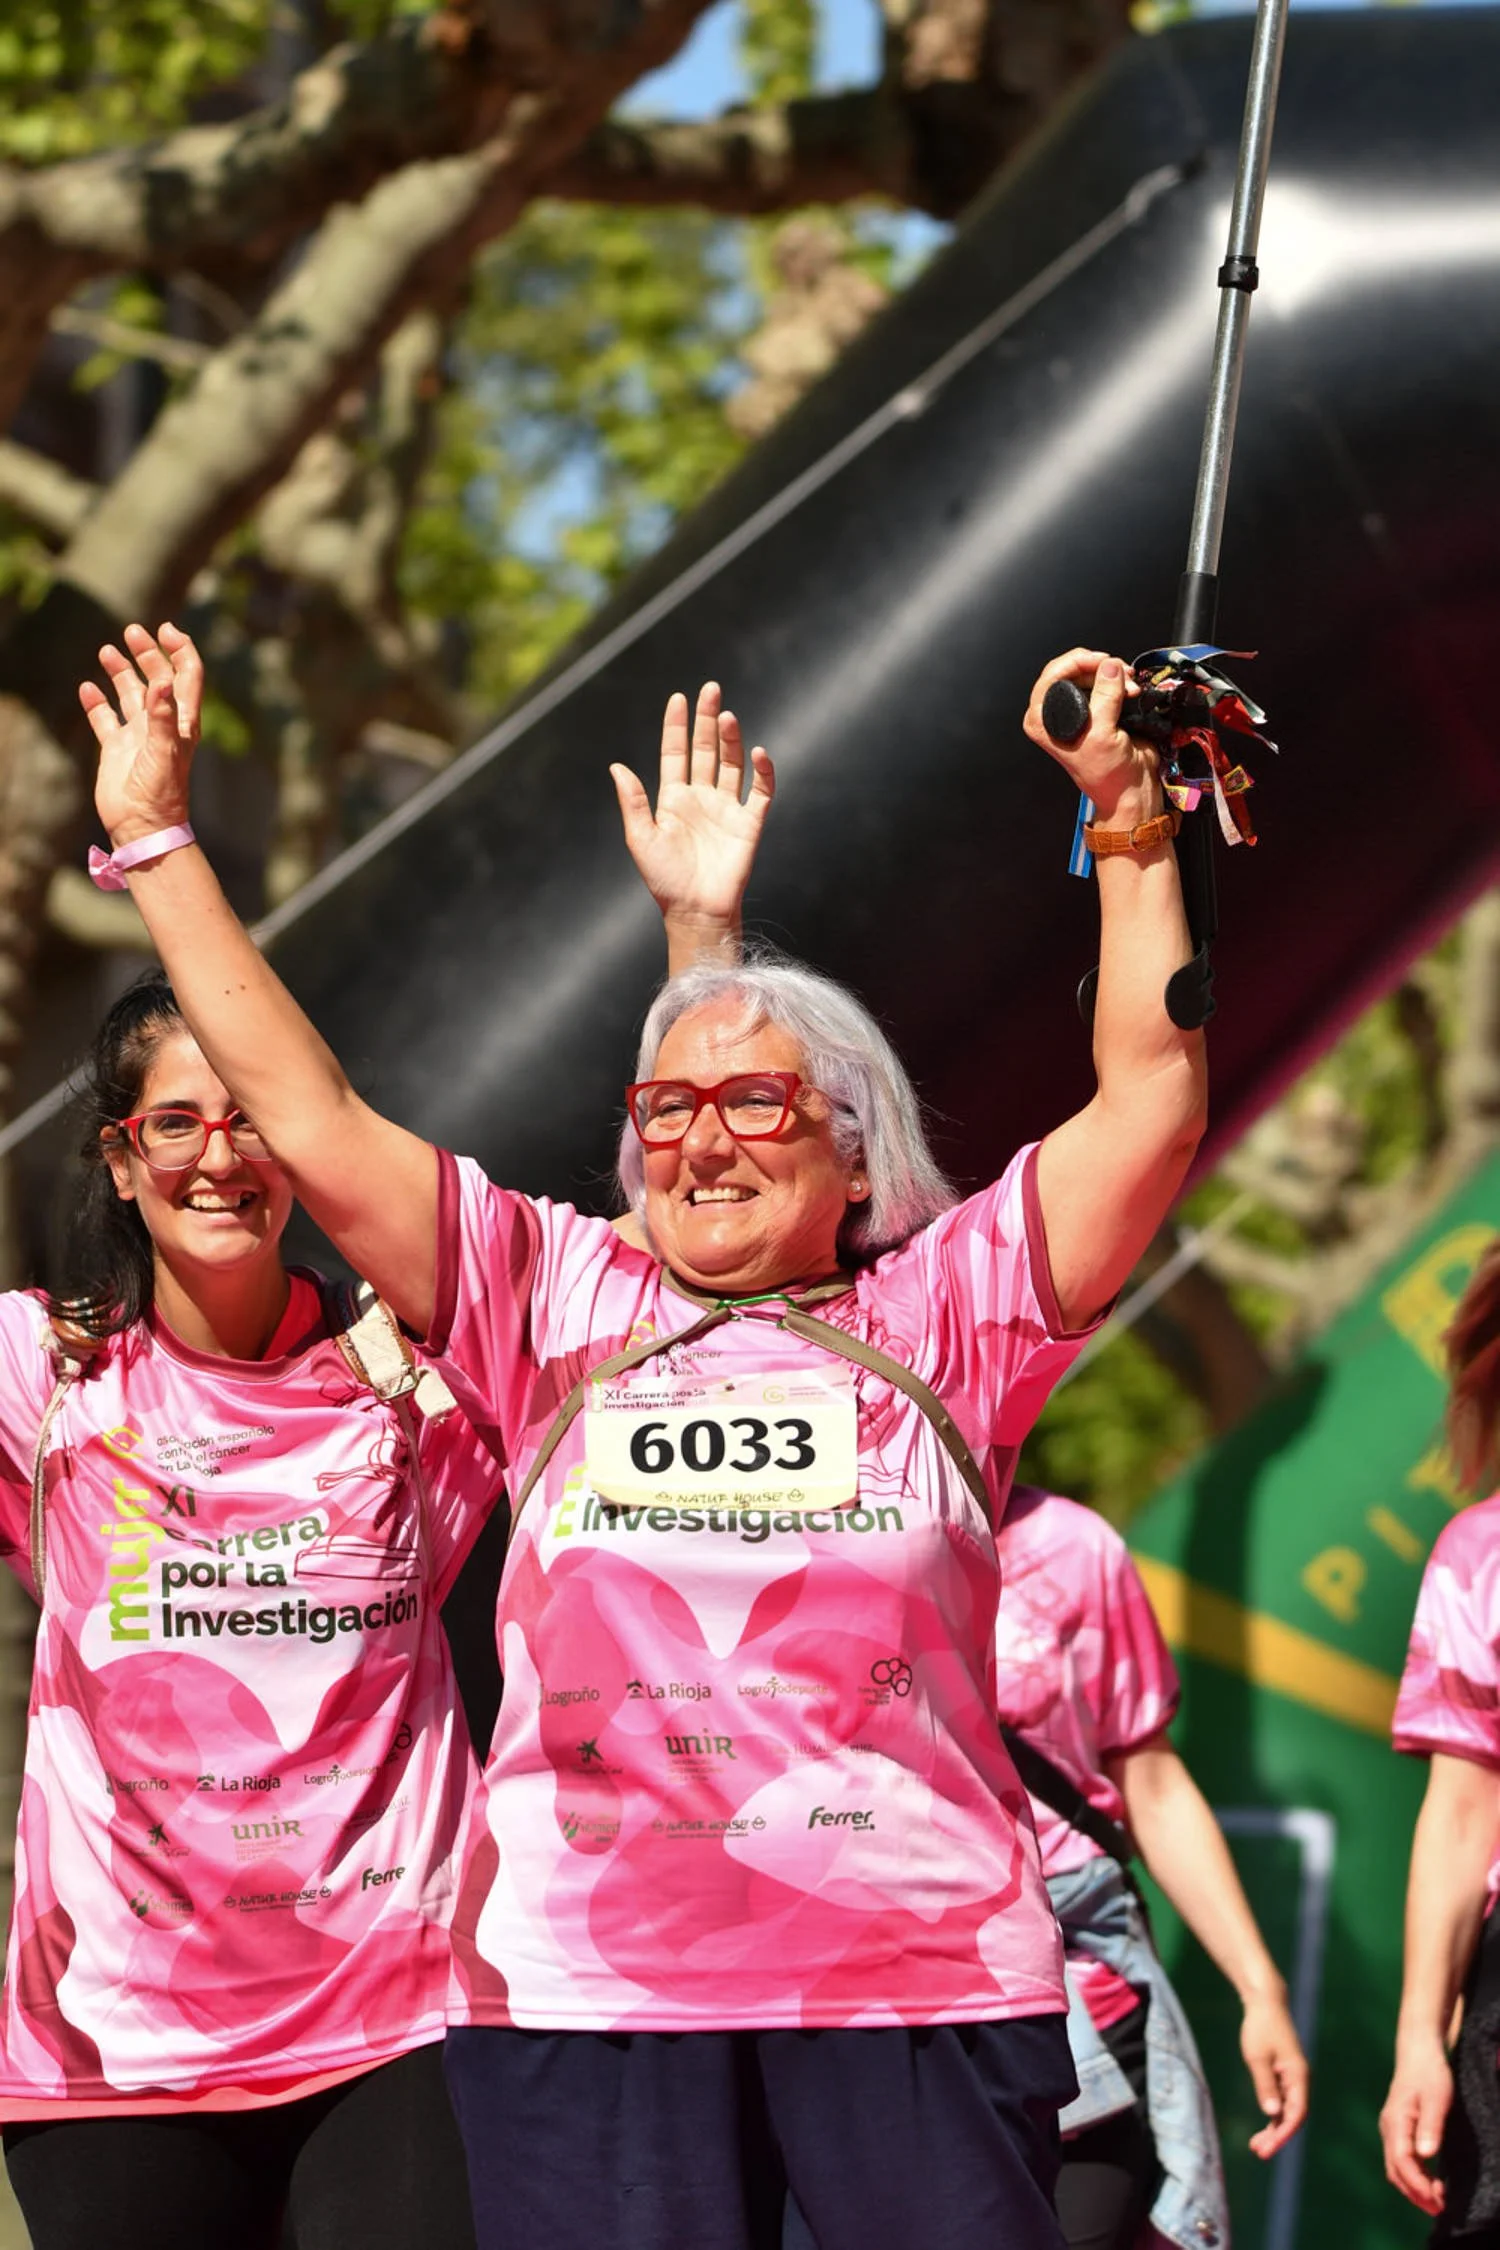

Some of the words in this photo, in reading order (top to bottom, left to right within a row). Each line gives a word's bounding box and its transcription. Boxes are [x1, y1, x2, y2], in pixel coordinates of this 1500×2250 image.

[156, 1434, 215, 1450] asoación
[630, 1418, 816, 1474] 6033
[156, 1484, 196, 1517] XI
[161, 1561, 234, 1598] por
[246, 1561, 287, 1587] la
[162, 1588, 418, 1643] Investigación
[647, 1684, 665, 1699] La
[669, 1681, 712, 1701] Rioja
[221, 1777, 238, 1792] La
[243, 1775, 281, 1792] Rioja
